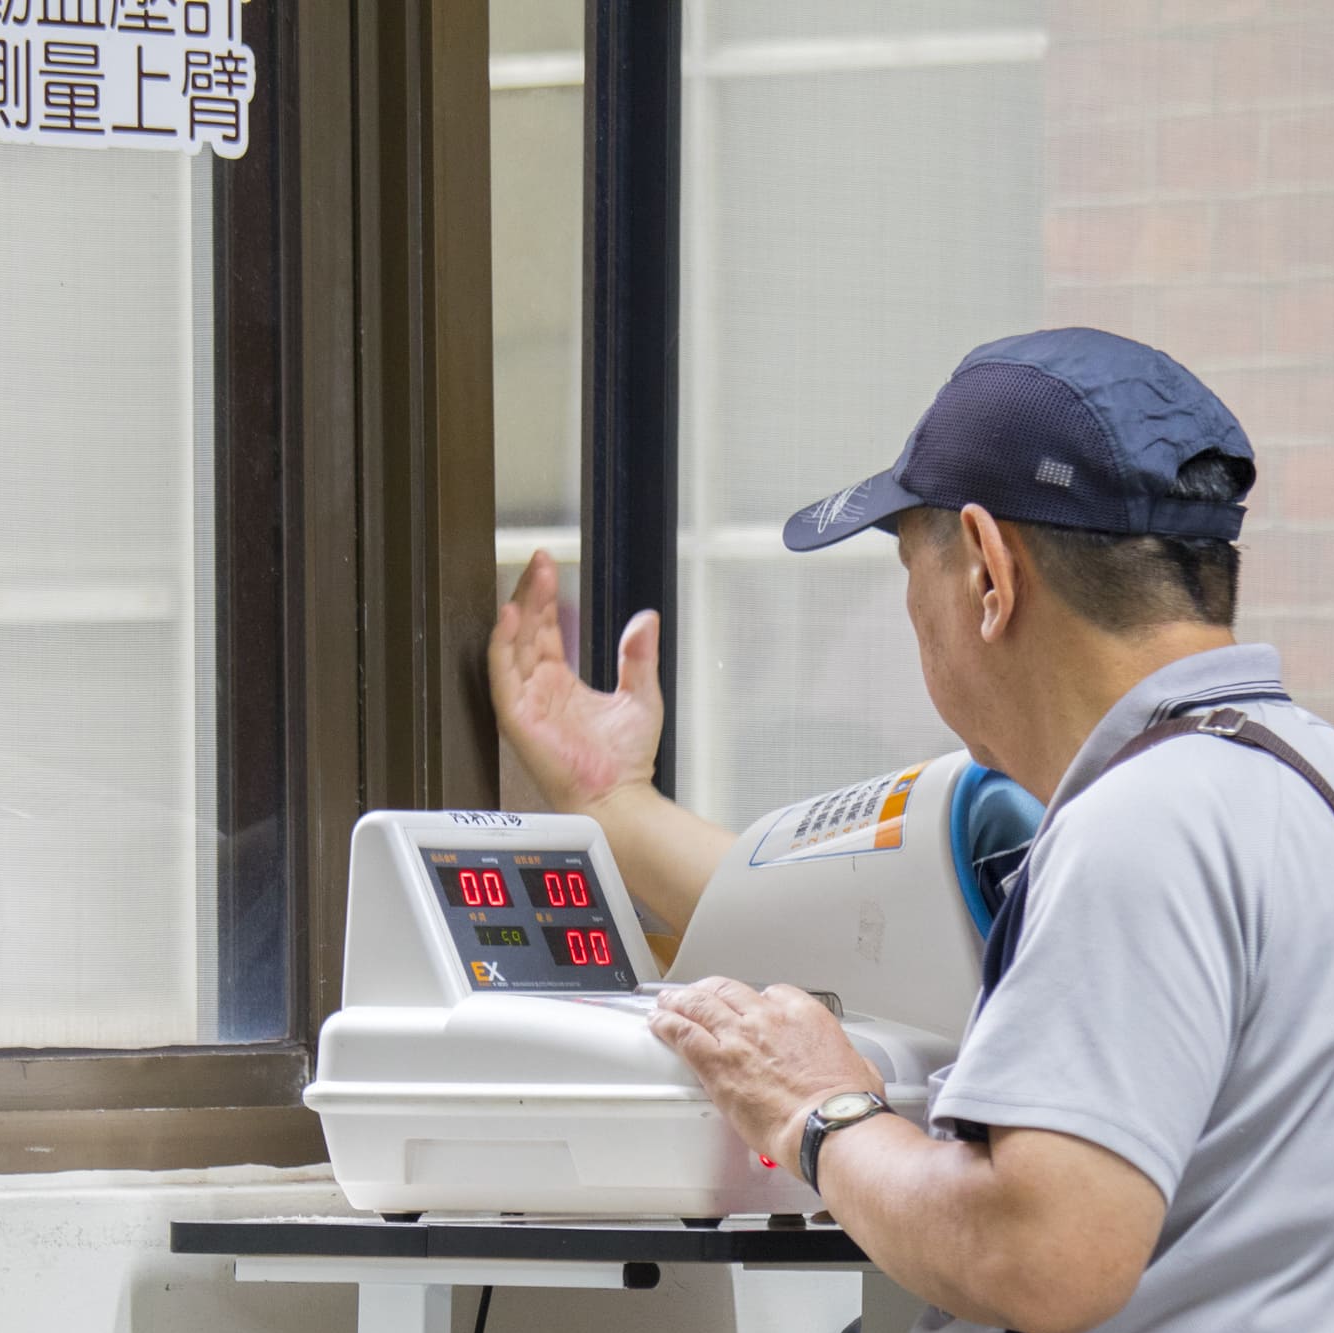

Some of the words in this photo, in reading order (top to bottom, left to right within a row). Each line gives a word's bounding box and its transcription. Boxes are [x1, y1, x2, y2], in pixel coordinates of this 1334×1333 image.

[460, 871, 505, 906] 00
[544, 872, 588, 907] 00
[567, 930, 611, 965] 00
[470, 961, 506, 981] EX
